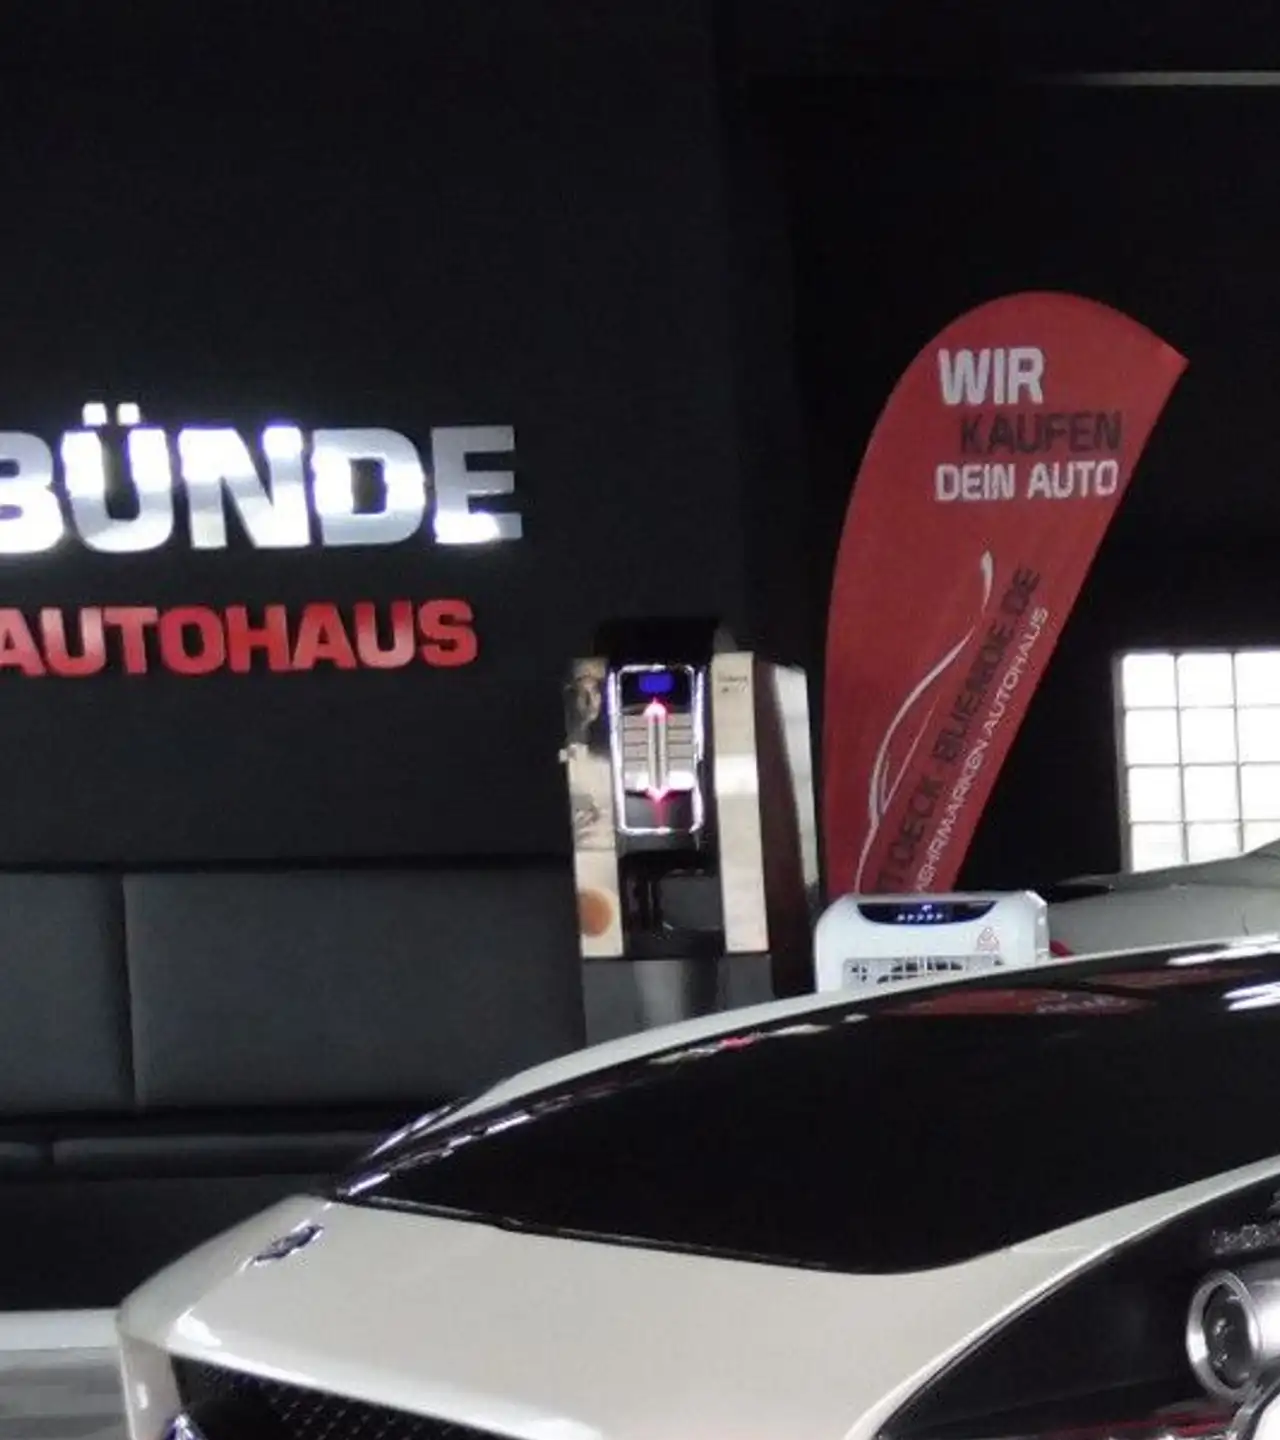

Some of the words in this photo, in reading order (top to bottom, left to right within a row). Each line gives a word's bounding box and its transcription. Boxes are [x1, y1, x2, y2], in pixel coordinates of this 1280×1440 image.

[938, 347, 1044, 405] WIR
[961, 411, 1122, 454] KAUFEN
[936, 463, 1016, 501] DEIN
[1027, 459, 1119, 499] AUTO
[0, 599, 479, 678] AUTOHAUS
[982, 606, 1049, 738] AUTOHAUS
